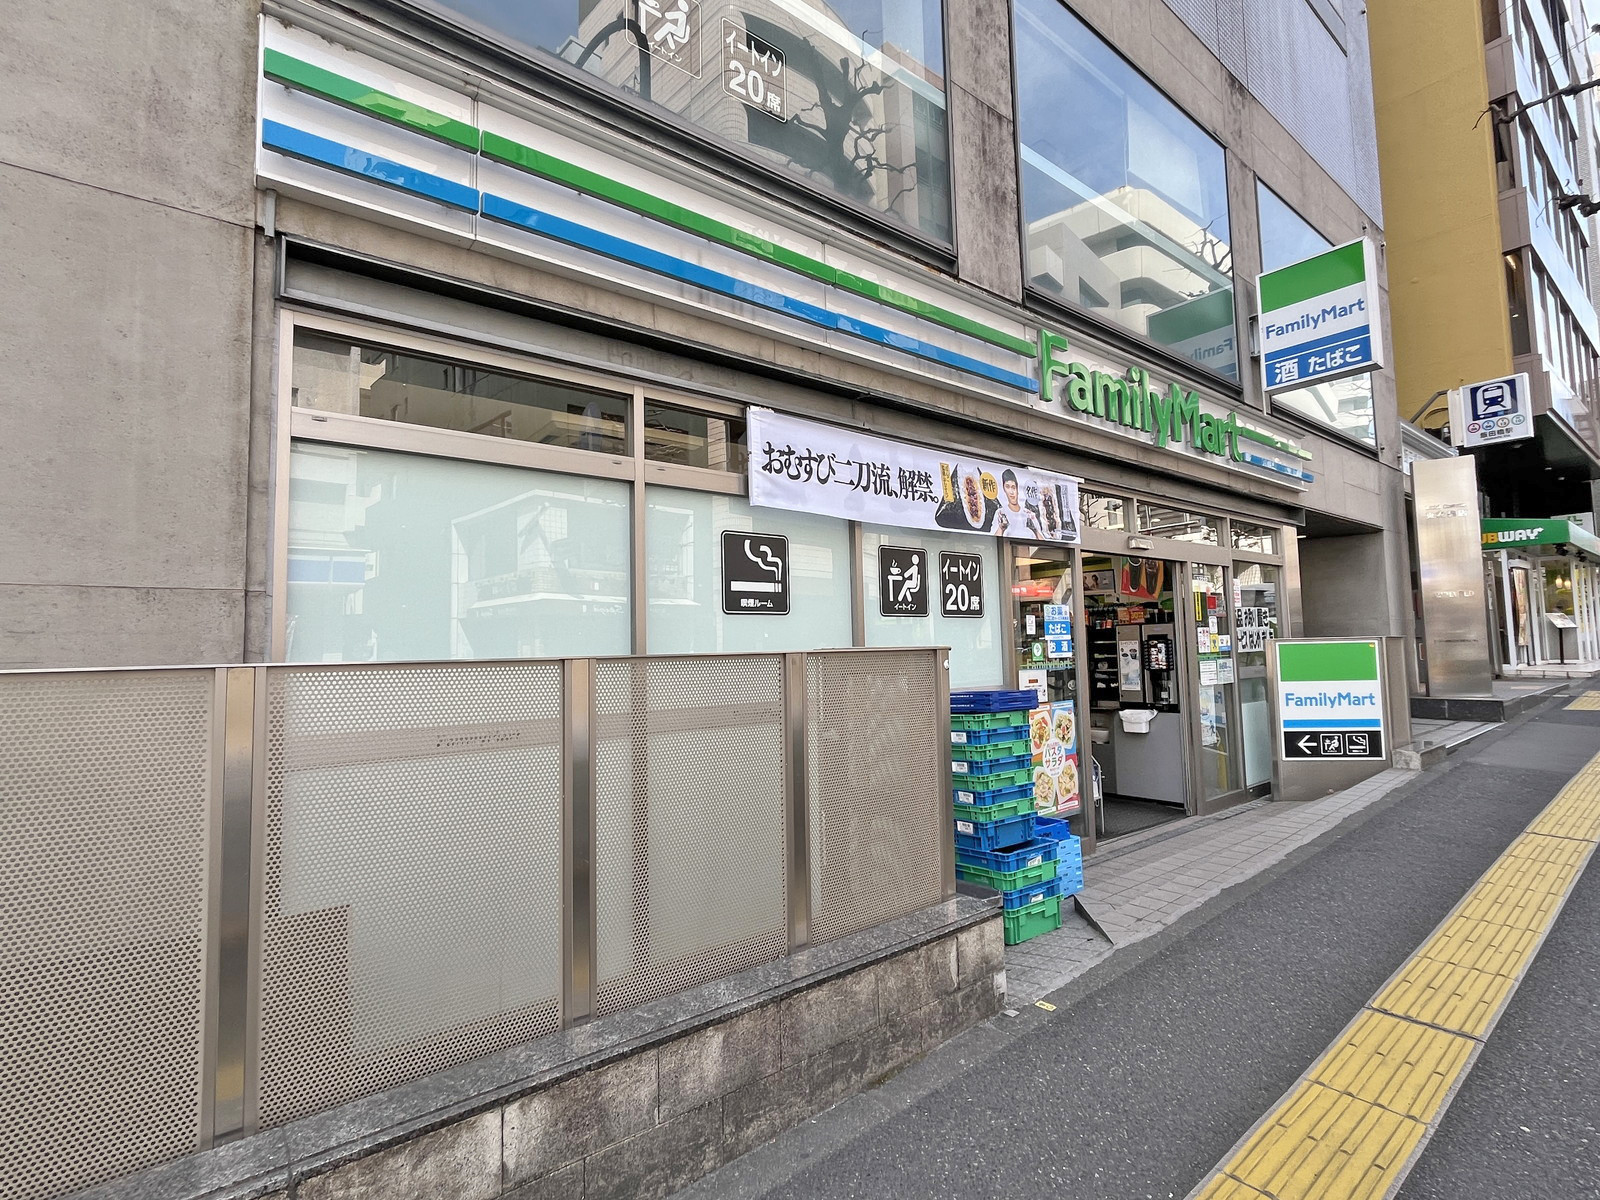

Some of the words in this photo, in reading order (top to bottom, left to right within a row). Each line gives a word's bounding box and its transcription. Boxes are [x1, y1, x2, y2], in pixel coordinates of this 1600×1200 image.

[648, 42, 682, 61] イートイン
[726, 31, 781, 77] イートイン
[729, 60, 781, 113] 20席
[1266, 298, 1365, 339] FamilyMart
[1274, 358, 1299, 383] 酒
[1308, 344, 1362, 373] たばこ
[1038, 329, 1243, 462] FamilyMart
[761, 441, 939, 504] おむすび二刀流、解禁。
[1481, 527, 1544, 544] UBWAY
[943, 558, 980, 581] イートイン
[894, 603, 917, 611] イートイン
[945, 583, 981, 612] 20席
[1048, 623, 1067, 634] たばこ
[1285, 692, 1376, 709] FamilyMart
[1045, 745, 1062, 758] パスタ
[1045, 754, 1064, 769] サラダ
